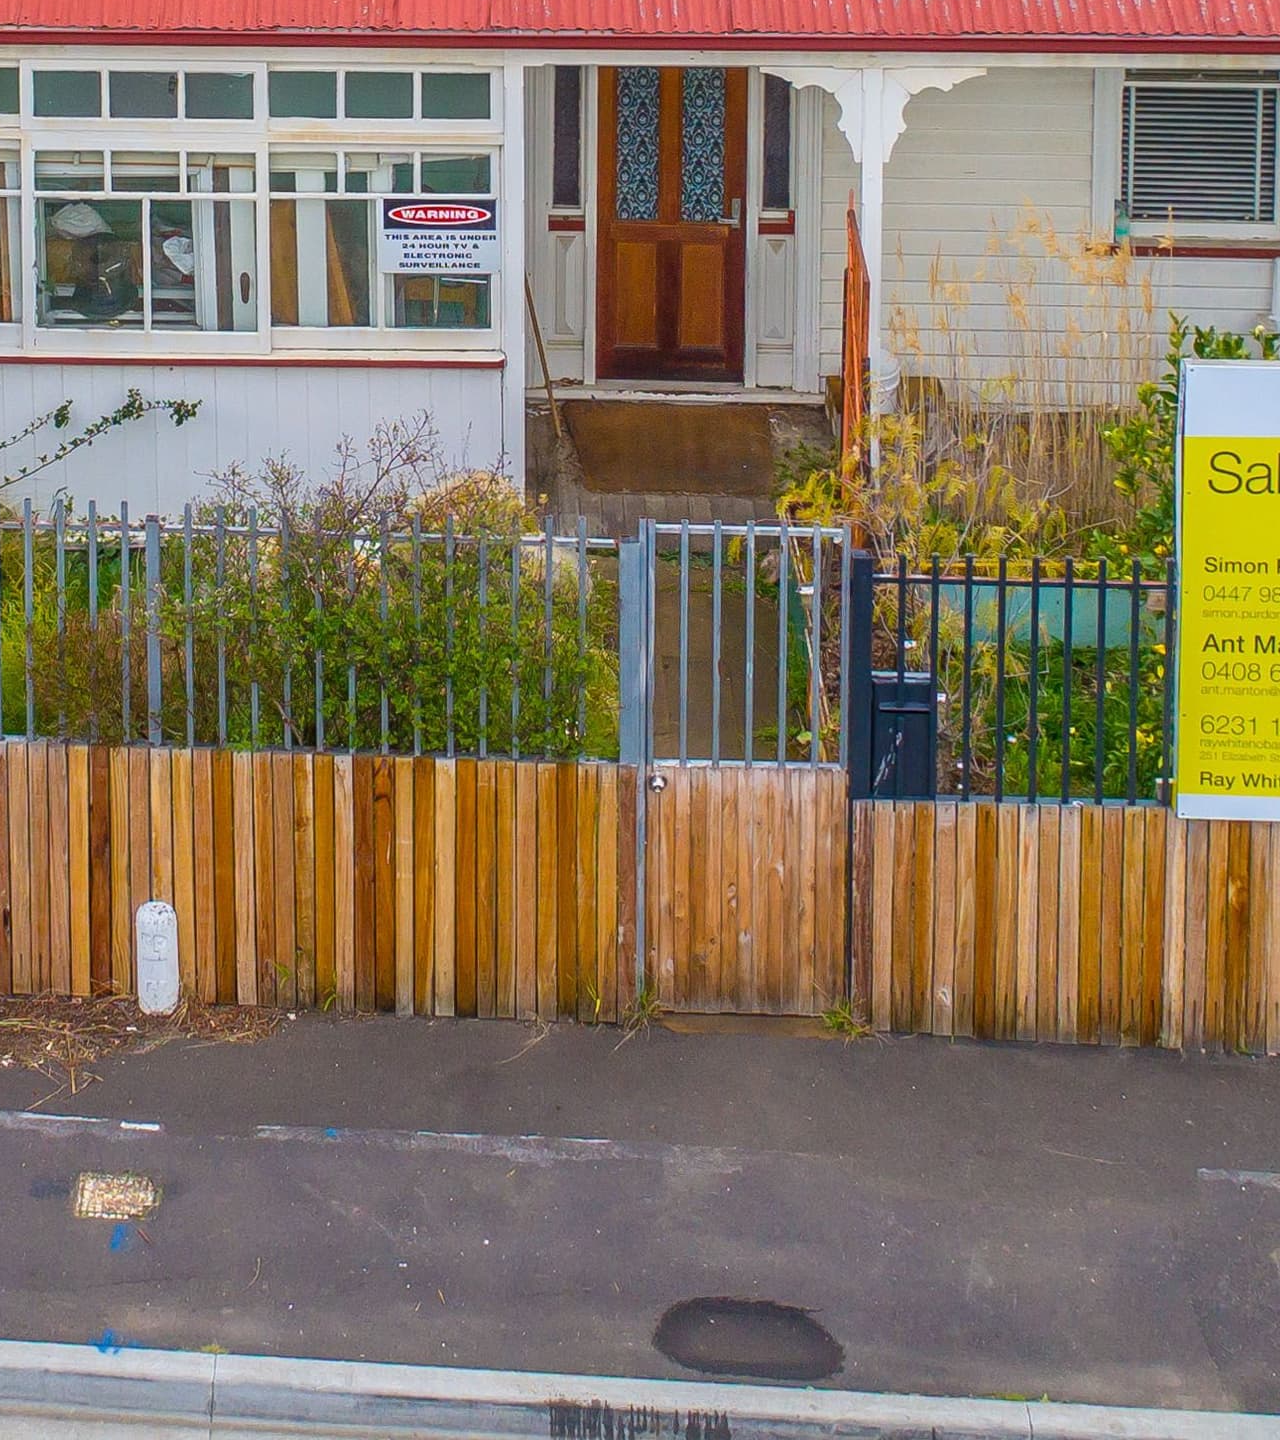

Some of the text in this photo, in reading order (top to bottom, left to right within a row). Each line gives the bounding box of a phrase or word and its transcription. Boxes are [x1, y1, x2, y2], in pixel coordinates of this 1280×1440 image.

[400, 209, 479, 220] WARNING
[1203, 556, 1269, 575] Simon
[1203, 584, 1252, 602] 0447
[1202, 633, 1245, 653] Ant
[1201, 661, 1262, 681] 0408
[1200, 714, 1257, 735] 6231
[1199, 771, 1236, 790] Ray
